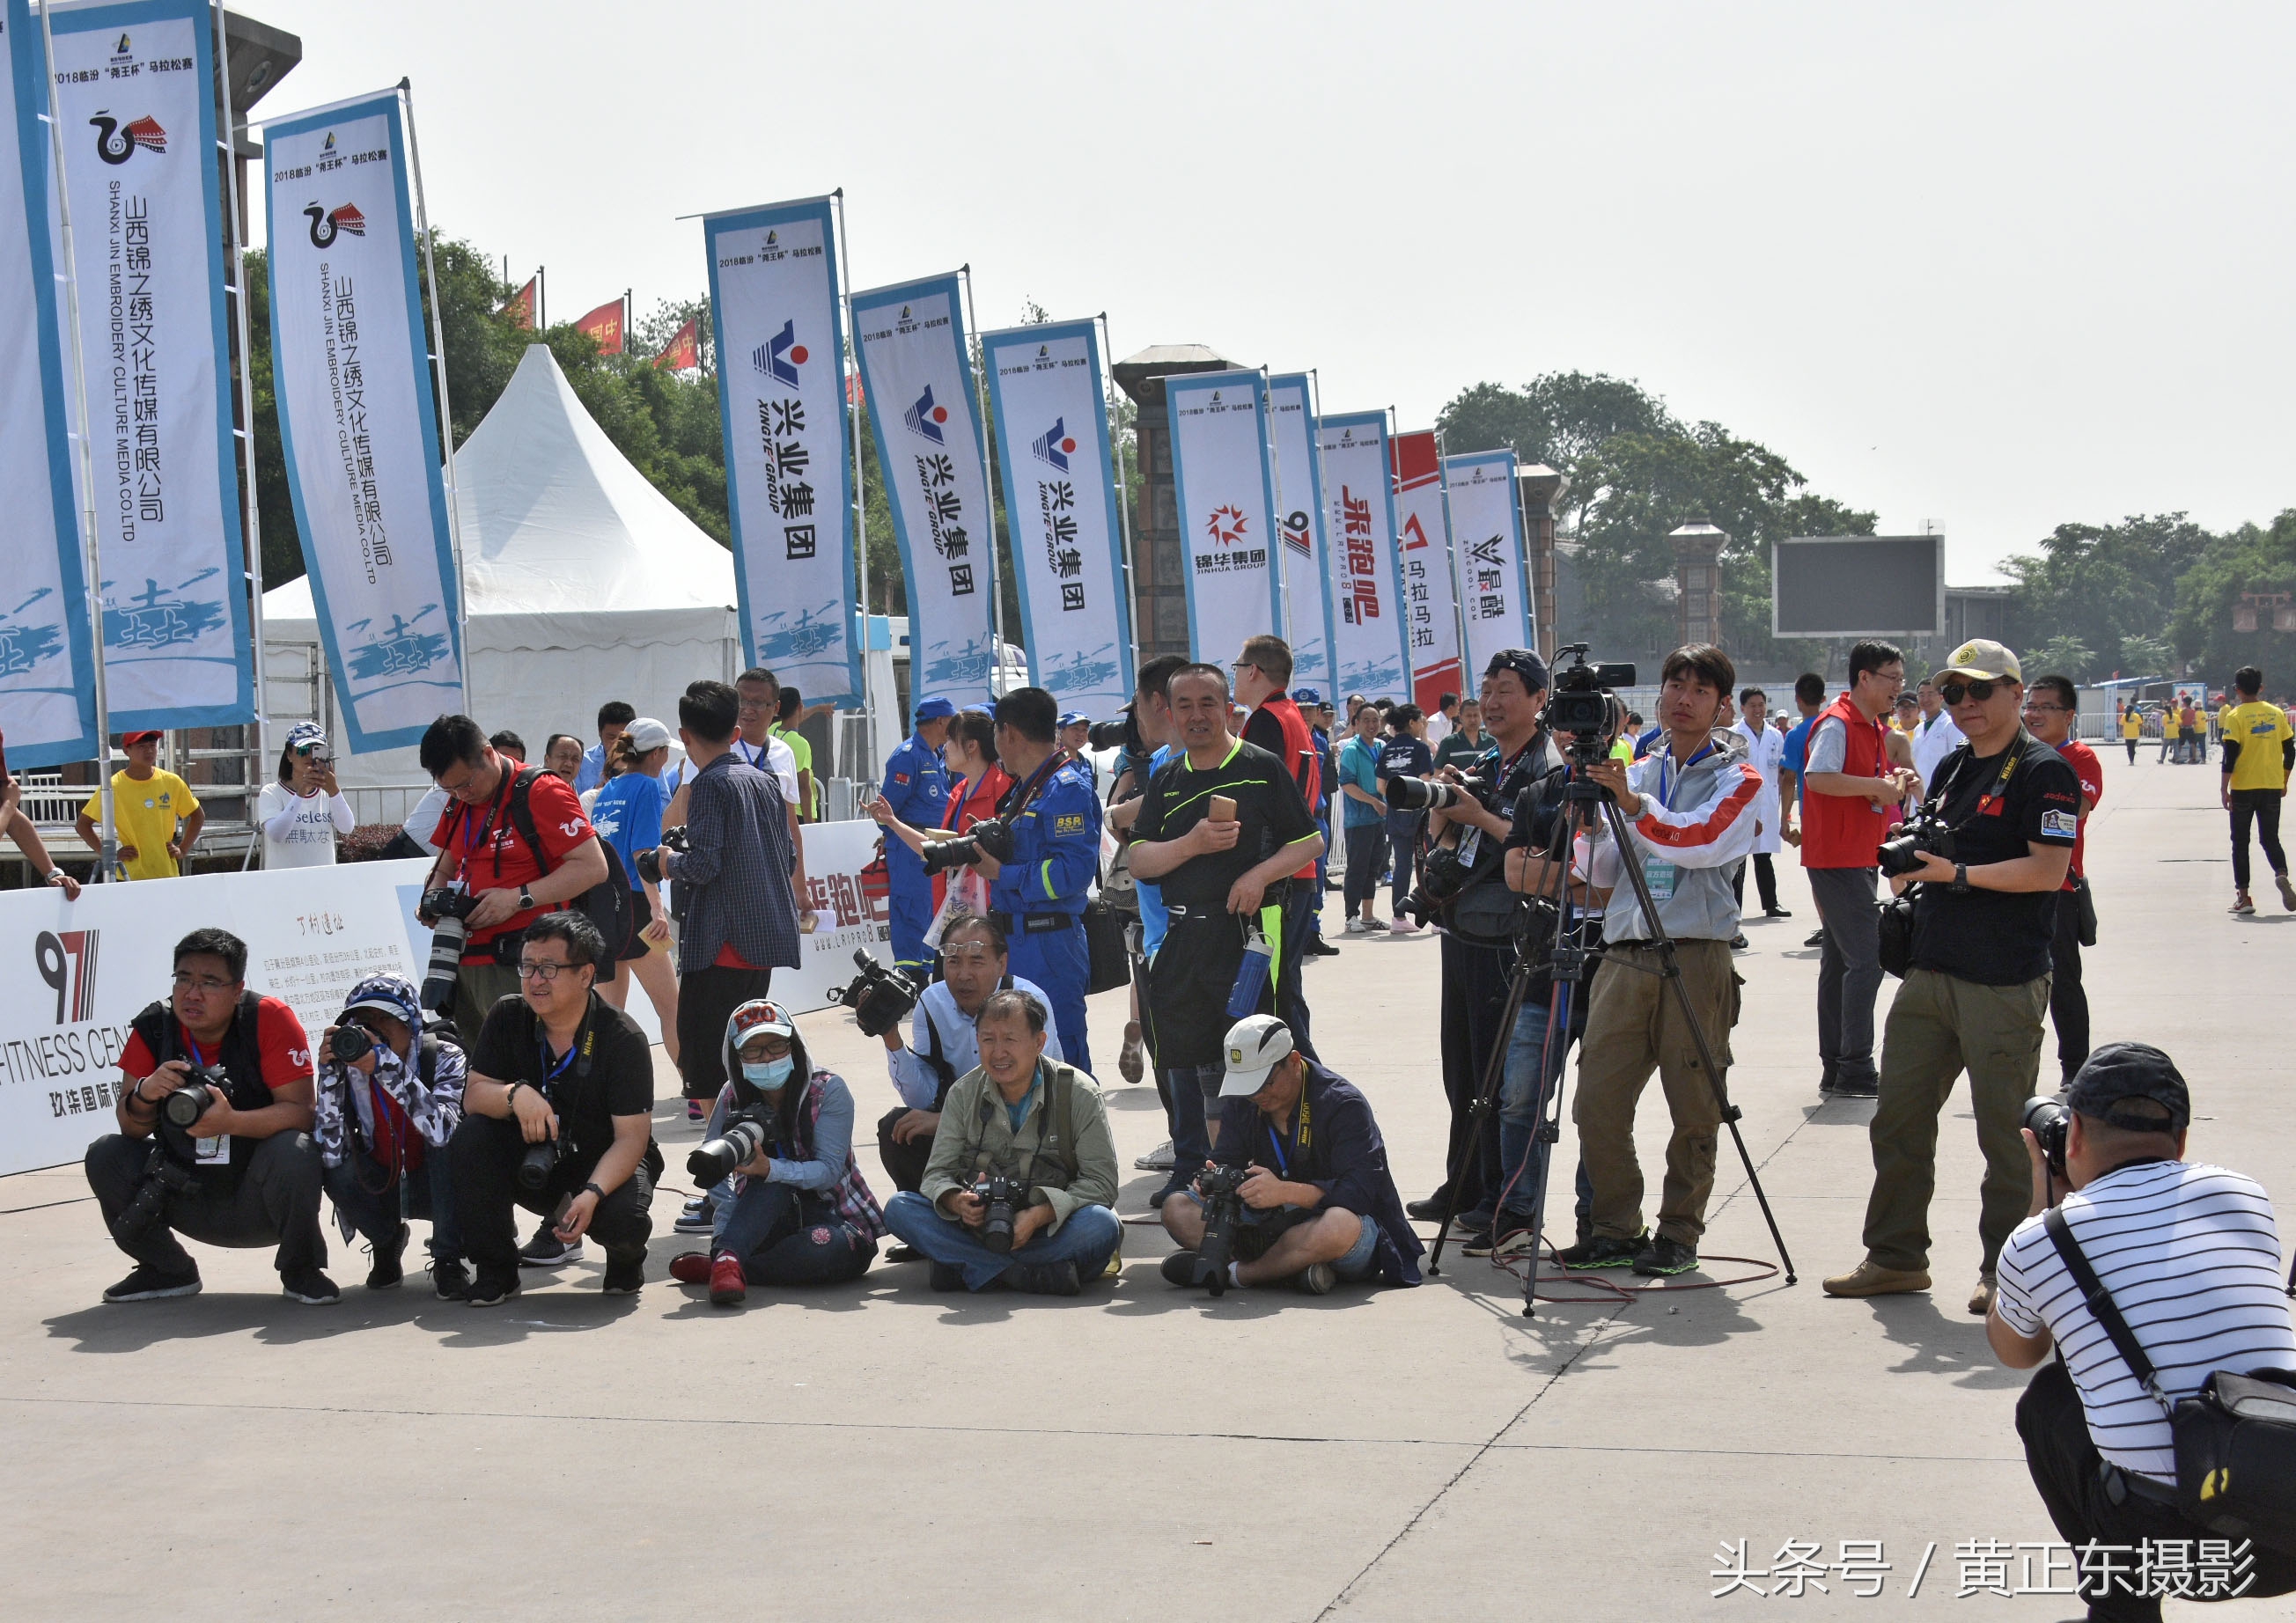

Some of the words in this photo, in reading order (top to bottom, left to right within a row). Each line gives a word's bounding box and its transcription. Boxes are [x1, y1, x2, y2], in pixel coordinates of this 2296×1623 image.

[54, 57, 194, 84] 018临汾“尧王杯”马拉松赛
[110, 180, 121, 234] SHANXI
[110, 239, 120, 259] JIN
[320, 263, 332, 312] SHANXI
[110, 264, 126, 363] EMBROIDERY
[324, 315, 334, 334] JIN
[125, 195, 164, 523] 山西锦之绣文化传媒有限公司
[326, 339, 346, 426] EMBROIDERY
[114, 367, 129, 434] CULTURE
[335, 275, 393, 566] 山西锦之绣文化传媒有限公司
[117, 439, 130, 485] MEDIA
[339, 430, 357, 489] CULTURE
[771, 399, 815, 561] 兴业集团
[765, 463, 779, 514] GROUP
[120, 488, 135, 542] CO.LTD
[353, 494, 366, 536] MEDIA
[926, 453, 975, 597] 兴业集团
[928, 510, 944, 556] GROUP
[361, 538, 376, 584] CO.LTD
[1045, 532, 1057, 575] GROUP
[1049, 481, 1085, 612] 兴业集团
[1195, 549, 1266, 569] 锦华集团
[1196, 566, 1231, 575] JINHUA
[1233, 562, 1266, 571] GROUP
[1409, 560, 1434, 647] 马拉马拉
[2001, 757, 2017, 780] Nikon
[296, 811, 332, 823] seless
[88, 1024, 134, 1069] CEN
[584, 1031, 594, 1056] Nikon
